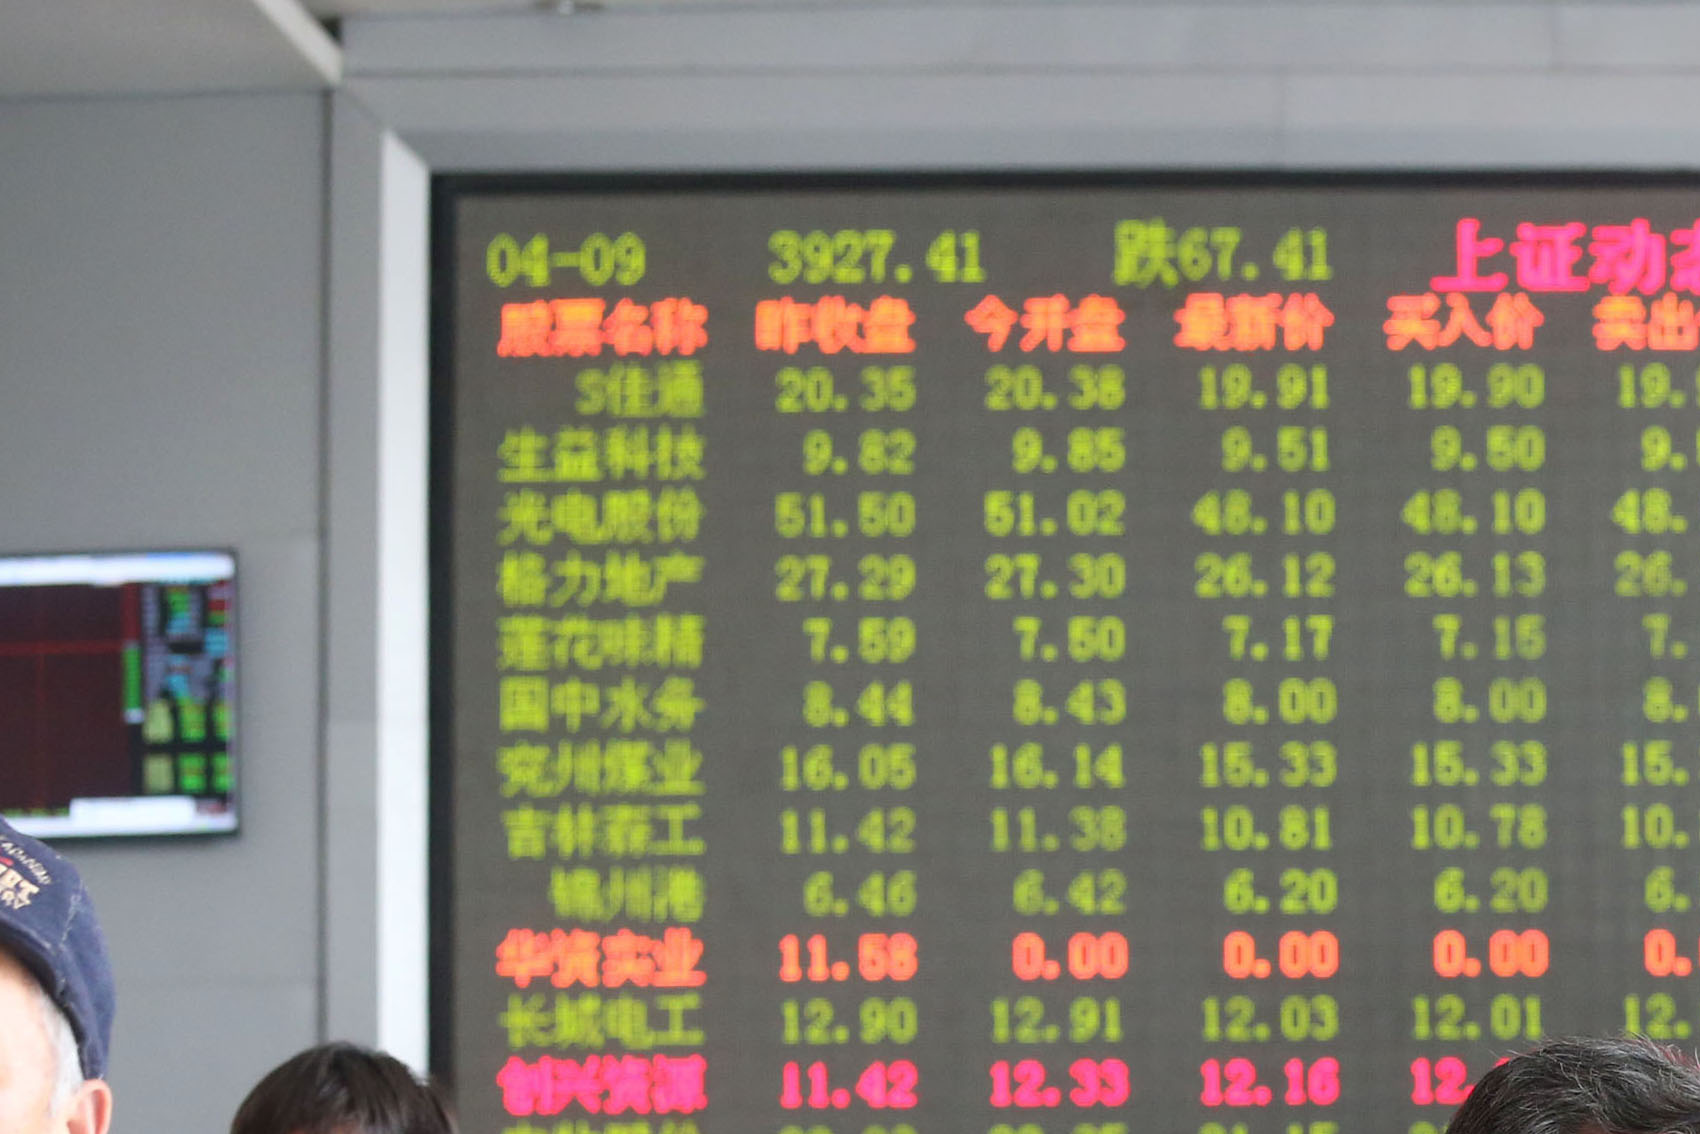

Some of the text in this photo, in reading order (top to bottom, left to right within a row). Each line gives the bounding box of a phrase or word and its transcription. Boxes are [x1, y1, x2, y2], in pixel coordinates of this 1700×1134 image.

[486, 231, 647, 287] 04-09
[768, 229, 986, 285] 3927.41
[1112, 217, 1334, 288] 跌67.41
[754, 295, 916, 354] 昨收盘
[965, 293, 1126, 353] 今开盘
[1173, 293, 1335, 351] 最新价
[1383, 292, 1545, 351] 买入价
[777, 367, 916, 413] 20.35
[987, 366, 1125, 410] 20.38
[1201, 365, 1328, 409] 19.91
[1410, 364, 1545, 408] 19.90
[499, 428, 703, 482] 生益科技
[804, 430, 916, 474] 9.82
[1013, 428, 1125, 472] 9.85
[1222, 427, 1329, 471] 9.51
[1432, 426, 1545, 470] 9.50
[776, 492, 915, 537] 51.50
[984, 490, 1125, 536] 51.02
[1193, 490, 1335, 534] 48.10
[1403, 489, 1545, 533] 48.10
[777, 555, 916, 600] 27.29
[986, 553, 1125, 599] 27.30
[1196, 553, 1334, 597] 26.12
[1405, 552, 1544, 597] 26.13
[804, 617, 916, 662] 7.59
[1014, 616, 1125, 661] 7.50
[1224, 615, 1333, 660] 7.17
[1434, 614, 1545, 659] 7.15
[804, 682, 913, 726] 8.44
[1014, 680, 1126, 725] 8.43
[1224, 678, 1337, 724] 8.00
[1434, 677, 1546, 723] 8.00
[782, 744, 916, 790] 16.05
[991, 743, 1124, 788] 16.14
[1202, 741, 1337, 787] 15.33
[1413, 741, 1547, 786] 15.33
[782, 808, 915, 853] 11.42
[992, 806, 1126, 851] 11.38
[1203, 806, 1331, 850] 10.81
[1413, 804, 1546, 849] 10.78
[805, 871, 916, 916] 6.46
[1013, 870, 1126, 914] 6.42
[1224, 869, 1338, 914] 6.20
[1435, 868, 1548, 912] 6.20
[779, 932, 919, 983] 11.58
[1011, 931, 1130, 981] 0.00
[1223, 930, 1340, 979] 0.00
[1432, 929, 1550, 978] 0.00
[784, 998, 917, 1044] 12.90
[992, 997, 1121, 1042] 12.91
[1204, 995, 1338, 1041] 12.03
[1413, 994, 1542, 1040] 12.01
[780, 1059, 919, 1110] 11.42
[989, 1058, 1131, 1108] 12.33
[1200, 1057, 1341, 1107] 12.16
